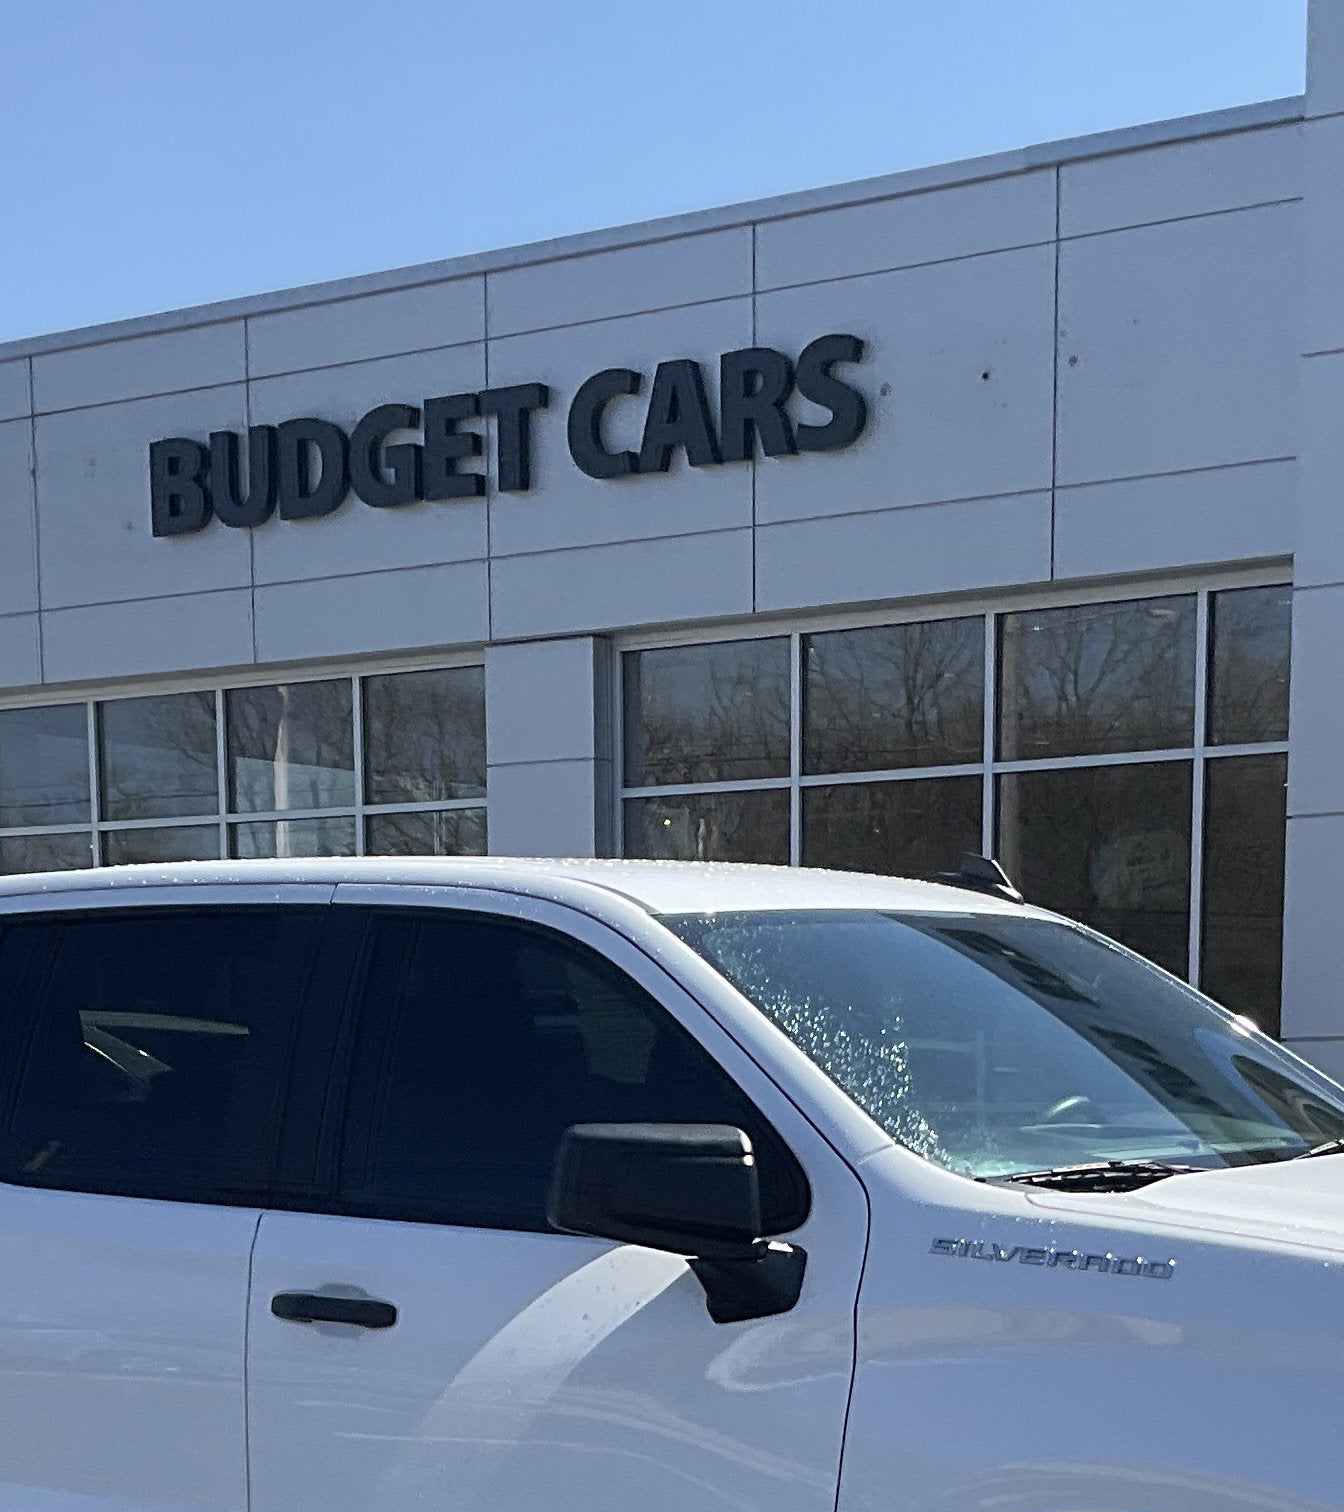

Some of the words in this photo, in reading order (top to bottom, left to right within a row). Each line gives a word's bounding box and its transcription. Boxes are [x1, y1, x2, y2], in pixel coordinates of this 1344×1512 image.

[150, 382, 549, 537] BUDGET
[567, 334, 867, 479] CARS
[929, 1237, 1176, 1279] SILVERADO
